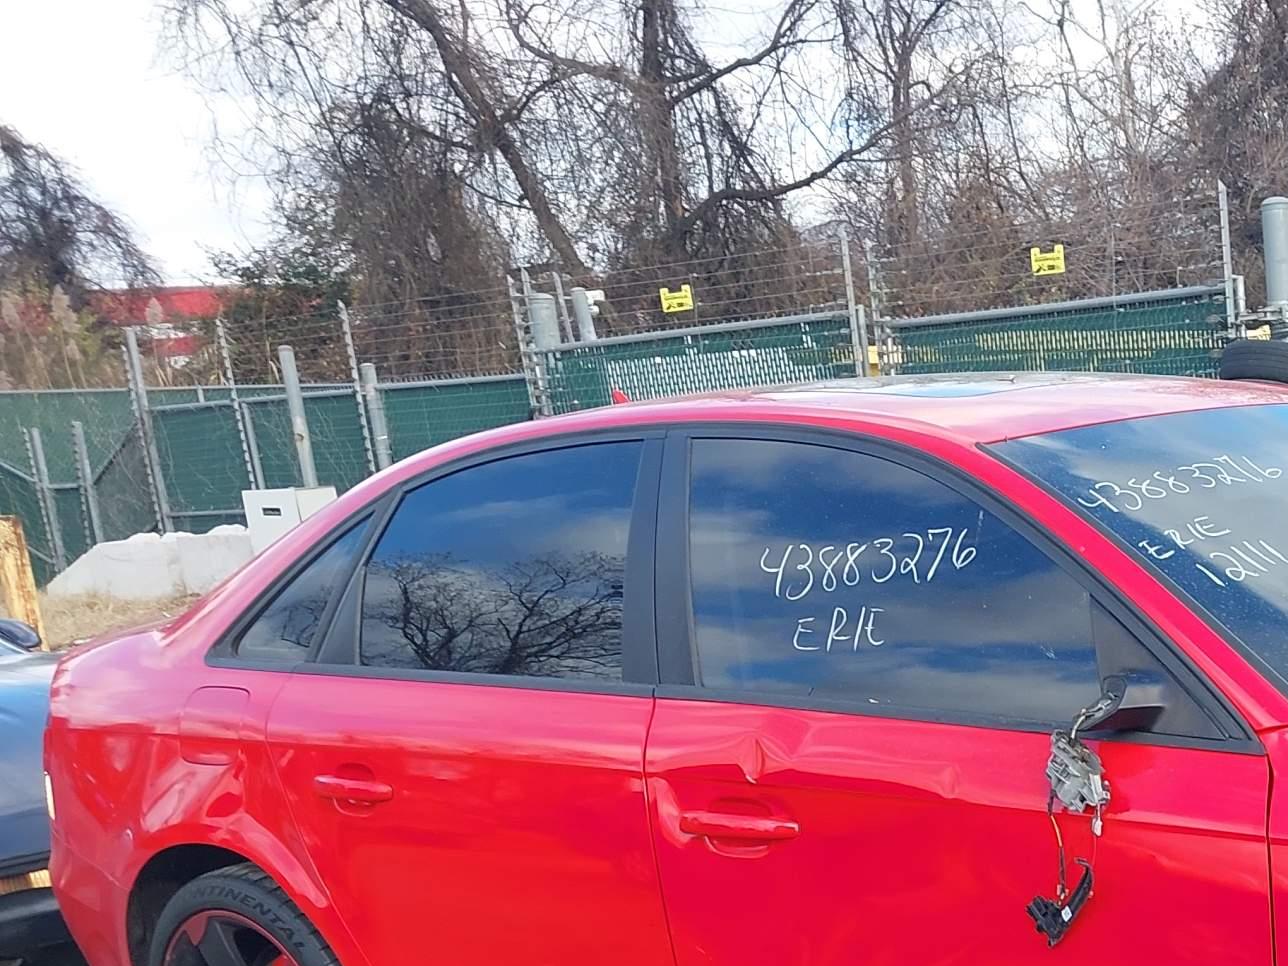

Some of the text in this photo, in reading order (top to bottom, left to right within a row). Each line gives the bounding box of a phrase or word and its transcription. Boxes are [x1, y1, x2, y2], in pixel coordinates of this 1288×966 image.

[1078, 455, 1283, 513] 43883276
[760, 528, 977, 600] 43883276
[1138, 516, 1231, 560] ERIE
[792, 606, 886, 652] ERIE
[194, 887, 307, 949] NTINENTAL
